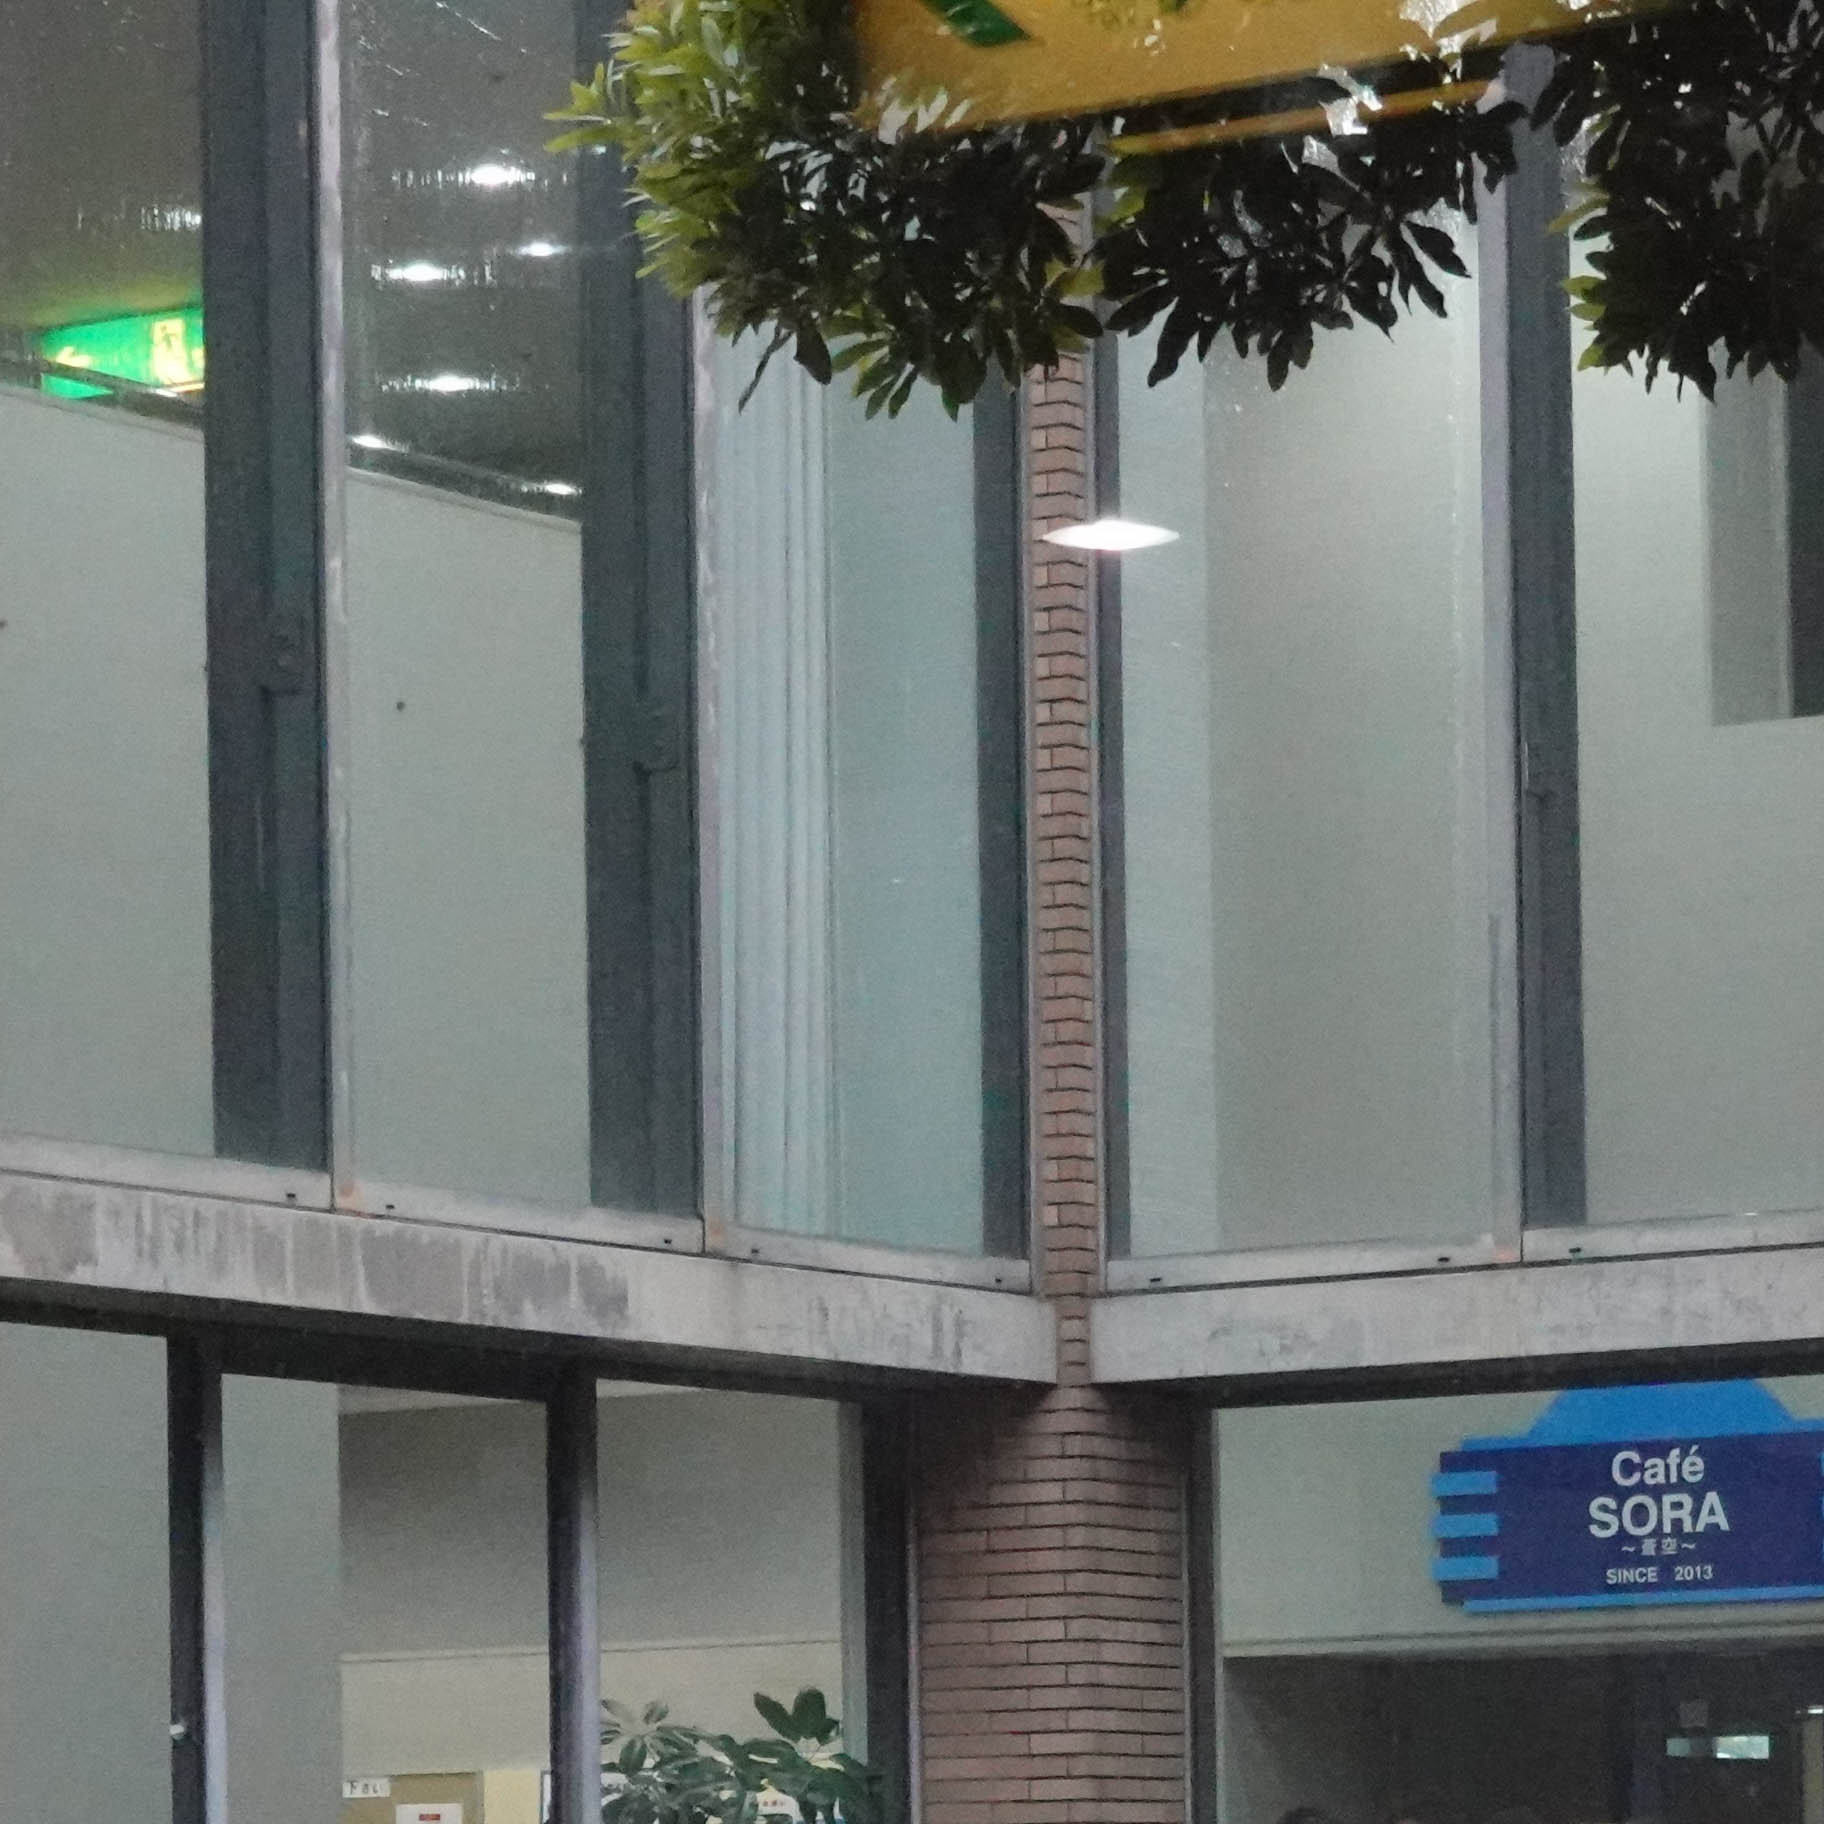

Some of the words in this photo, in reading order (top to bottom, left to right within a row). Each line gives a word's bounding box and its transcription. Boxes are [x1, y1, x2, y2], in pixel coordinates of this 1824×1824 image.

[1611, 1444, 1705, 1487] Café
[1588, 1491, 1731, 1538] SORA
[1605, 1566, 1658, 1585] SINCE
[1674, 1564, 1714, 1581] 2013
